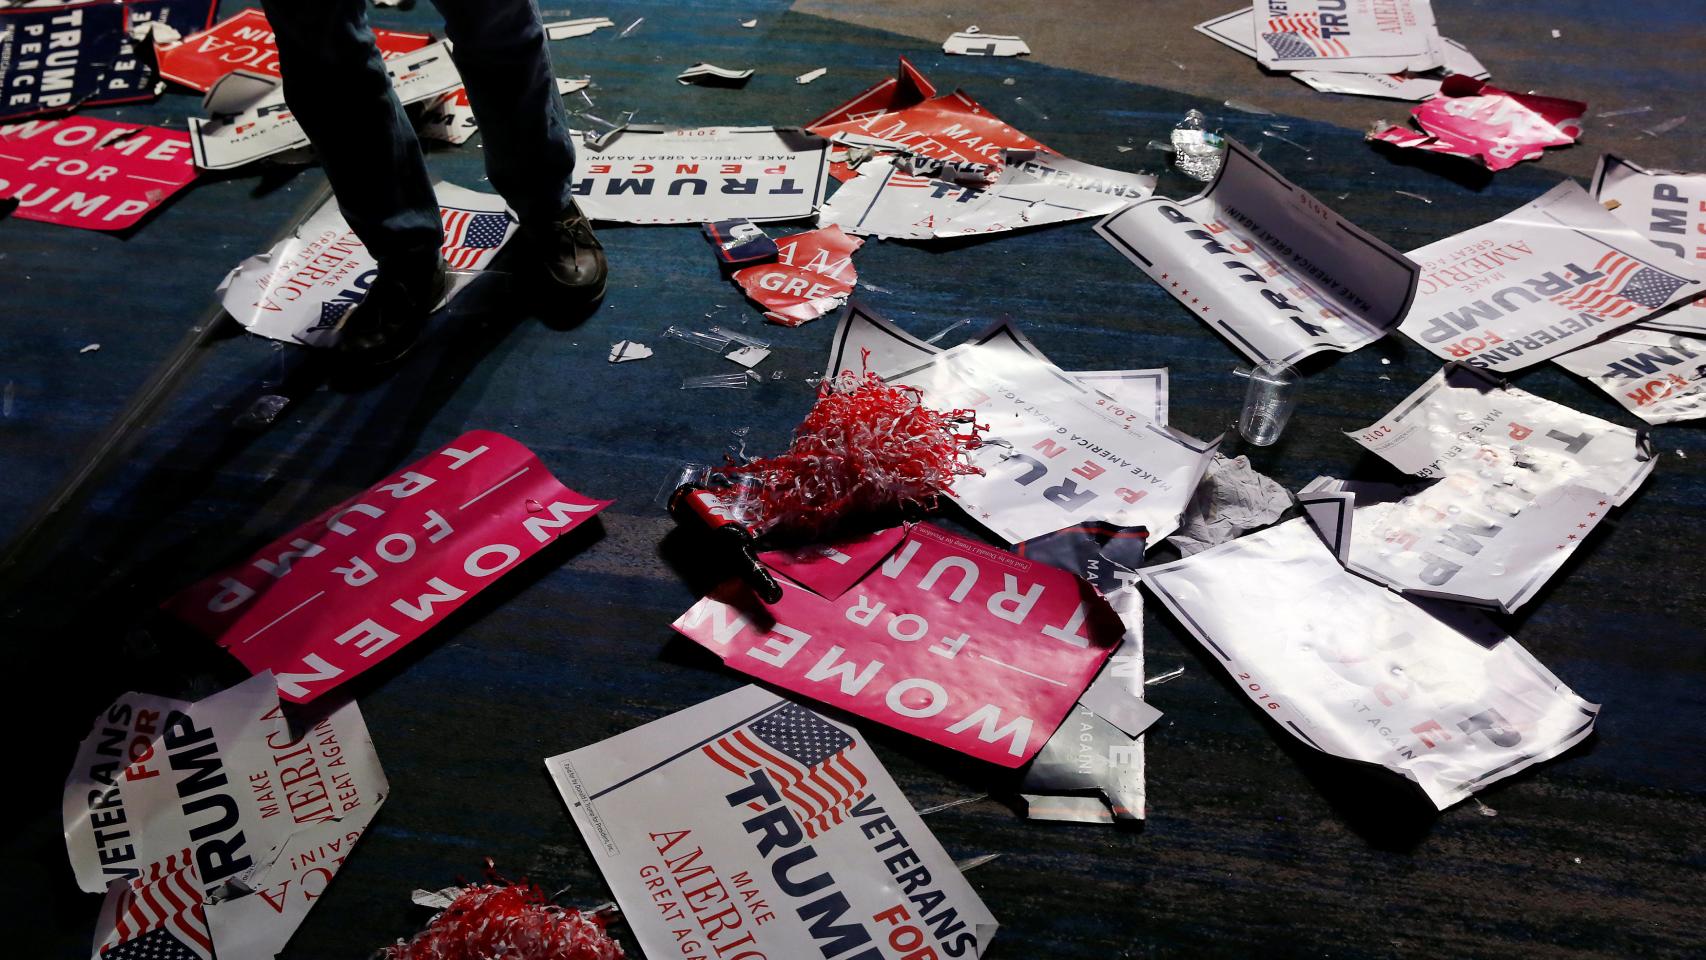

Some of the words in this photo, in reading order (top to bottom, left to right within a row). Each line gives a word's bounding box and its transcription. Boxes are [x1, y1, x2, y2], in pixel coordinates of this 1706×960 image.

[9, 24, 44, 106] PENCE
[38, 9, 83, 107] TRUMP
[0, 120, 192, 165] WOME
[676, 128, 717, 137] 2016
[27, 156, 119, 182] FOR
[587, 163, 787, 175] PENCE
[0, 178, 150, 222] UMP
[1223, 204, 1264, 233] AGAIN!
[1300, 193, 1329, 220] 2016
[299, 230, 338, 260] GREAT
[1259, 230, 1292, 256] GREAT
[1451, 239, 1496, 261] GREAT
[252, 229, 363, 313] MERICA
[321, 260, 361, 288] MAKE
[1157, 205, 1330, 337] TRUMP
[1293, 252, 1340, 289] AMERICA
[1461, 272, 1507, 294] MAKE
[1338, 287, 1373, 313] MAKE
[1420, 262, 1607, 344] TRUMP
[1442, 329, 1505, 358] FOR
[1465, 312, 1606, 369] VETERANS
[1472, 408, 1503, 433] MAKE
[1069, 433, 1132, 468] AMERICA
[1131, 468, 1174, 492] MAKE
[207, 444, 490, 614] TRUMP
[329, 509, 455, 587] FOR
[276, 501, 600, 699] WOMEN
[845, 593, 970, 662] FOR
[690, 599, 1037, 759] WOMEN
[1236, 671, 1282, 713] 2016
[124, 708, 161, 782] FOR
[1079, 722, 1095, 775] AGAIN!
[87, 703, 141, 889] VETERANS
[163, 709, 253, 898] RUMP
[249, 770, 281, 819] MAKE
[639, 865, 686, 922] GREAT
[730, 870, 776, 926] MAKE
[849, 793, 978, 958] VETERANS
